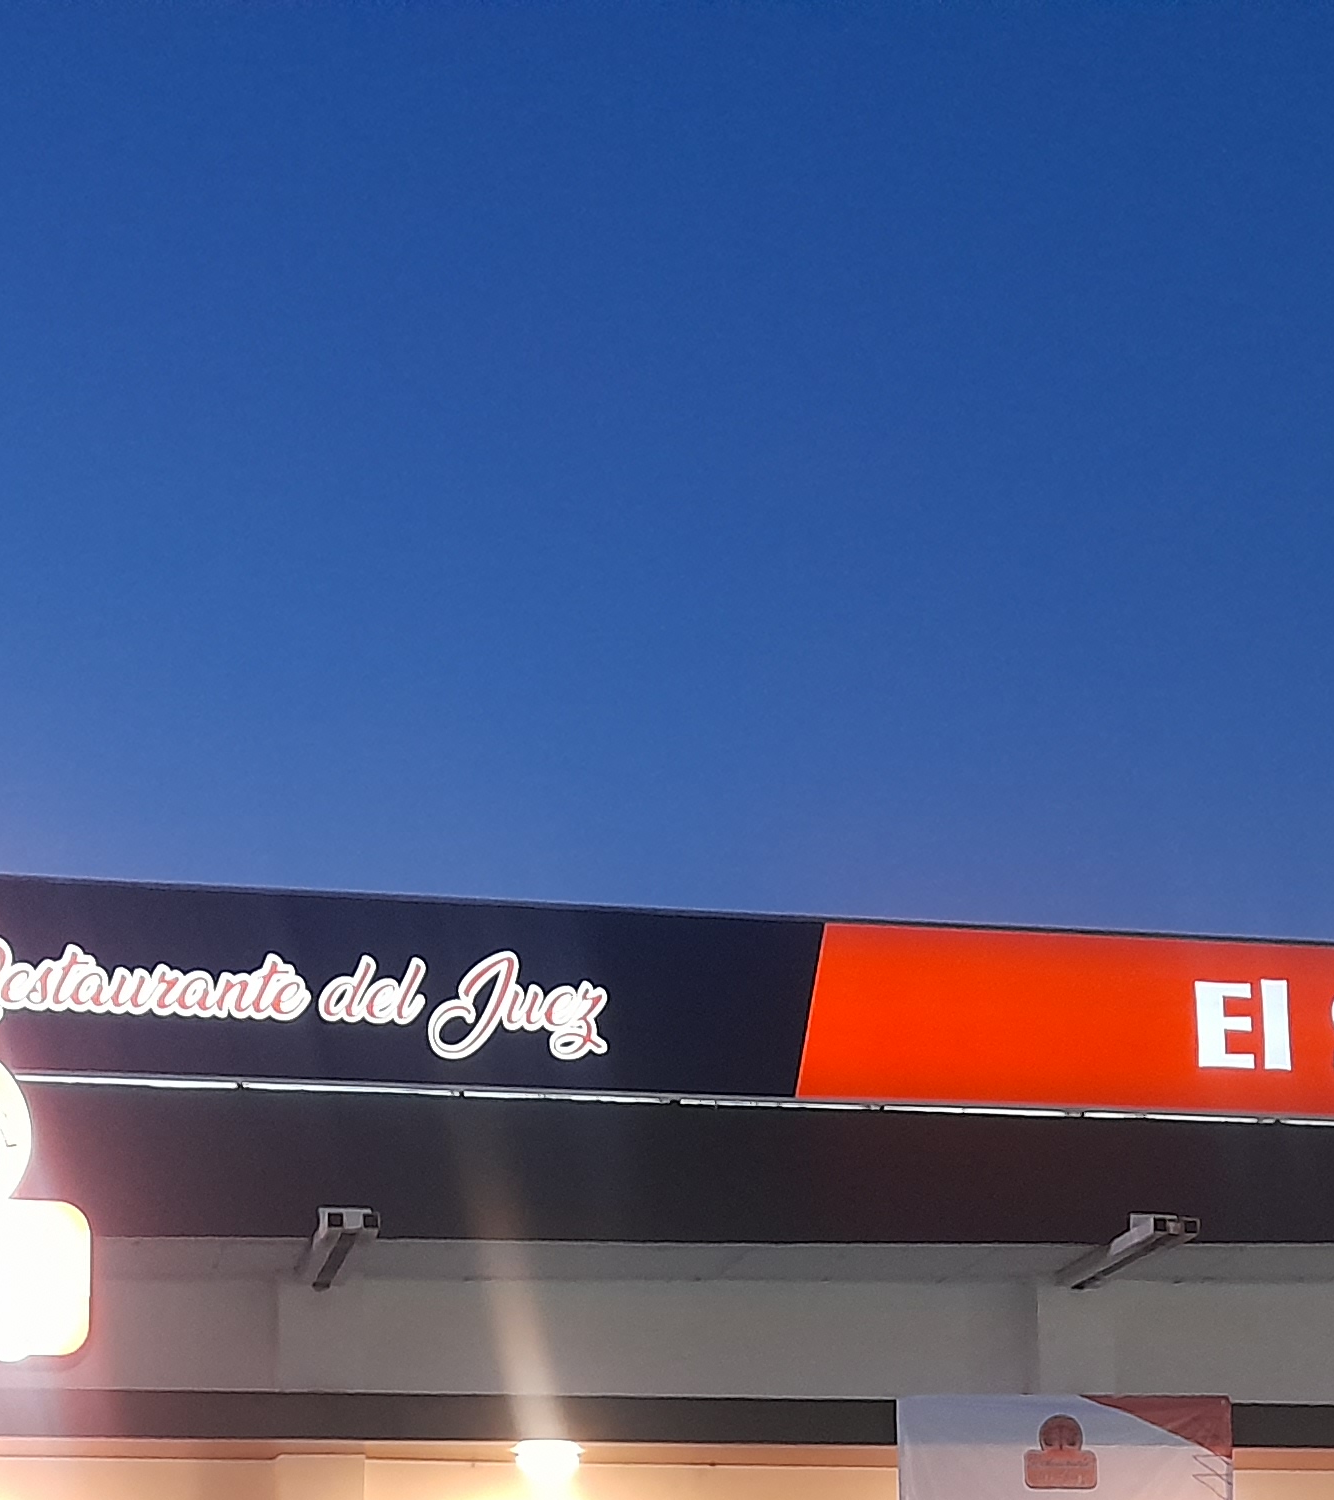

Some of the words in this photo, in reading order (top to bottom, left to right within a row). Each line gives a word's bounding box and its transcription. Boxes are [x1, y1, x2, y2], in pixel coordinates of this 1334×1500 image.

[319, 954, 426, 1023] del
[427, 951, 608, 1059] Juez
[1194, 979, 1291, 1070] El
